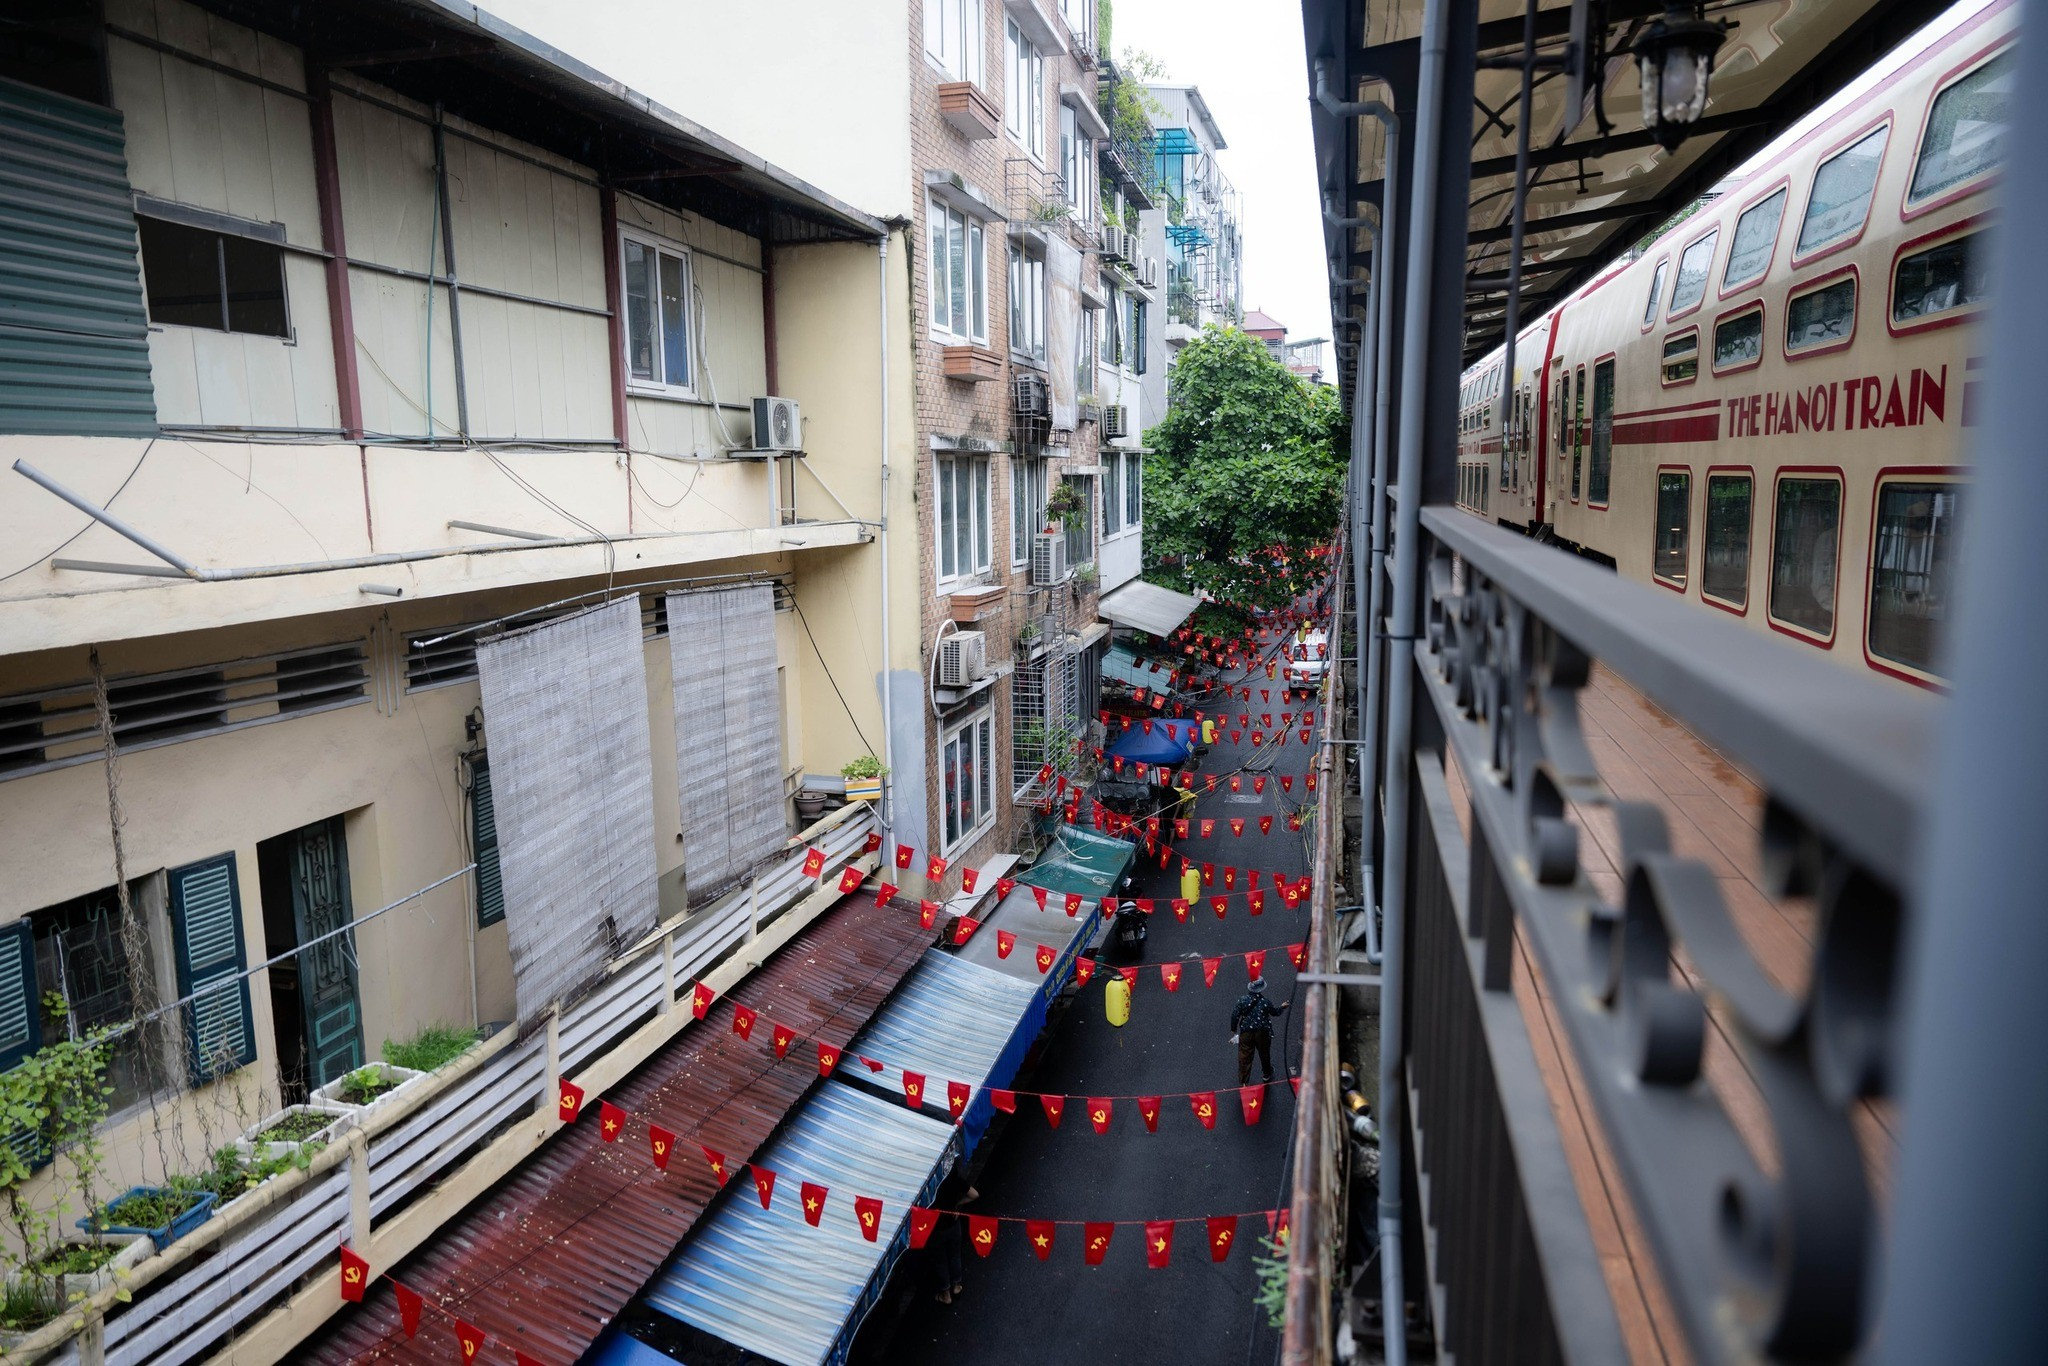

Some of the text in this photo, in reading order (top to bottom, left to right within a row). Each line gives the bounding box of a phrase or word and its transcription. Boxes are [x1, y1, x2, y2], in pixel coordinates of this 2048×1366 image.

[1727, 364, 1947, 437] THE HANOI TRAIN
